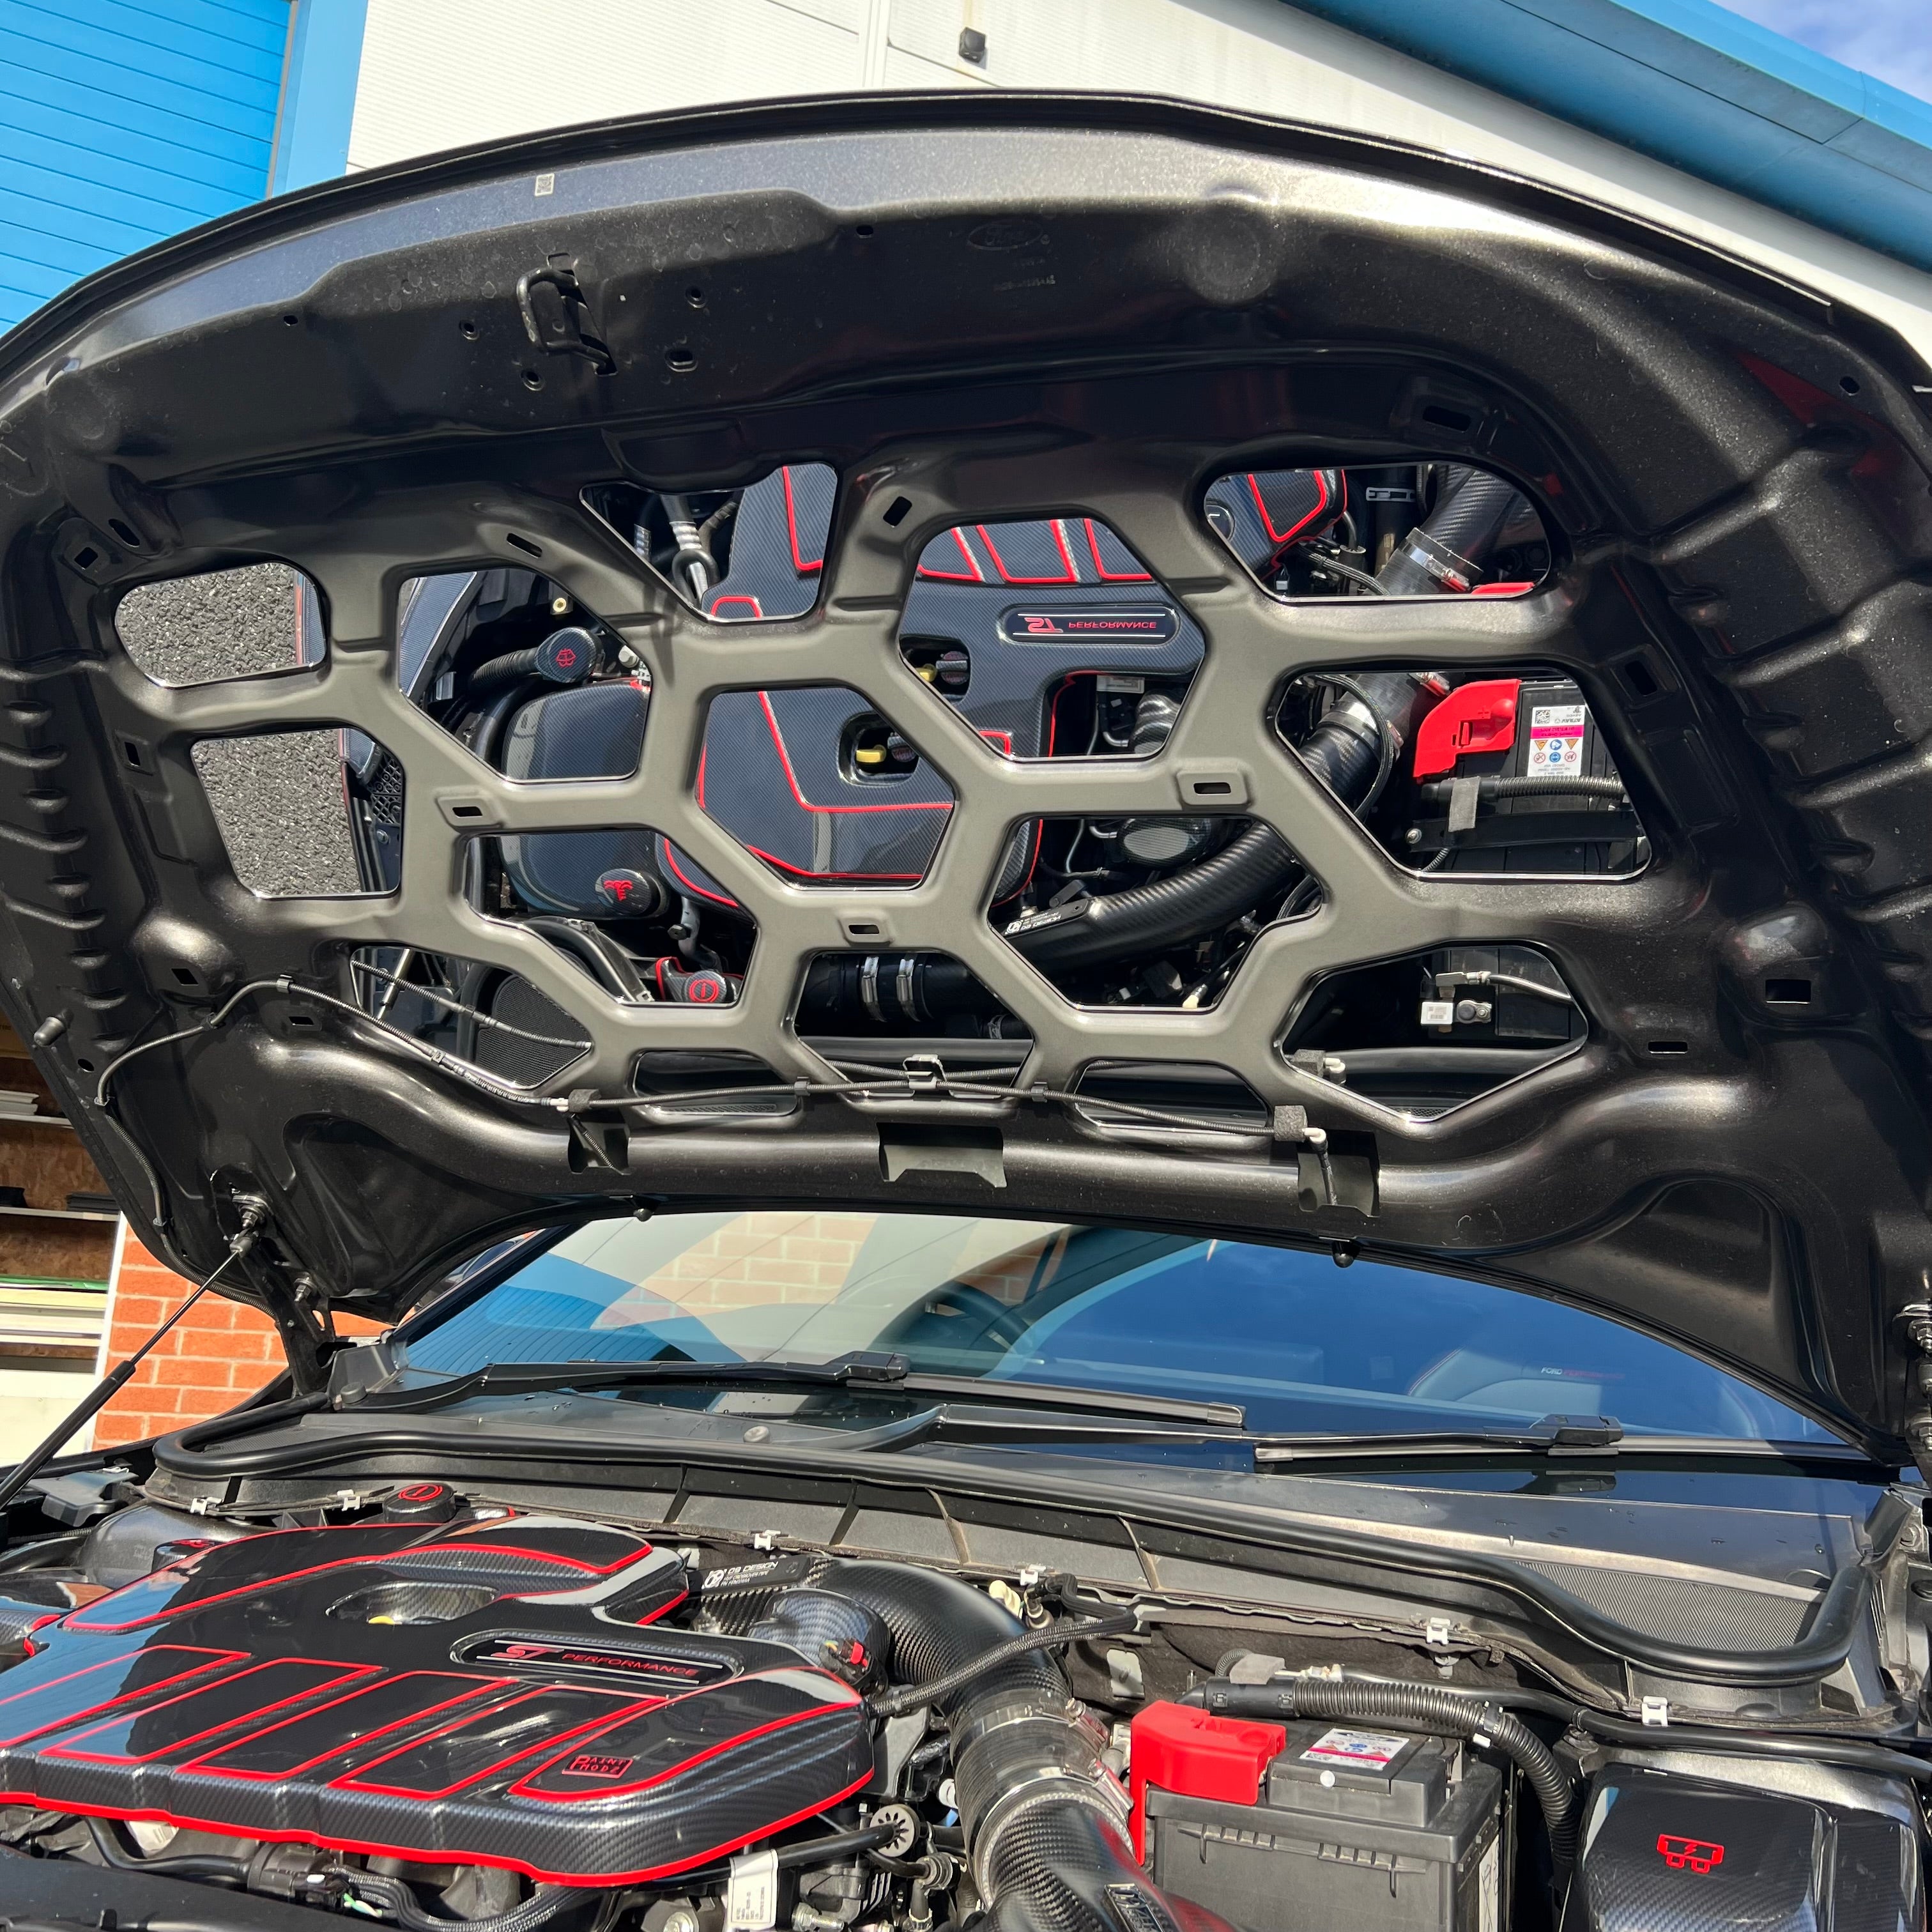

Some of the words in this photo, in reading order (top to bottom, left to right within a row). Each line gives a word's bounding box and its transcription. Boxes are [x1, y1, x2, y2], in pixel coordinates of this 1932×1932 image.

[1541, 1367, 1563, 1376] FORD
[491, 1644, 565, 1660] ST
[562, 1653, 700, 1678] PERFORMANCE
